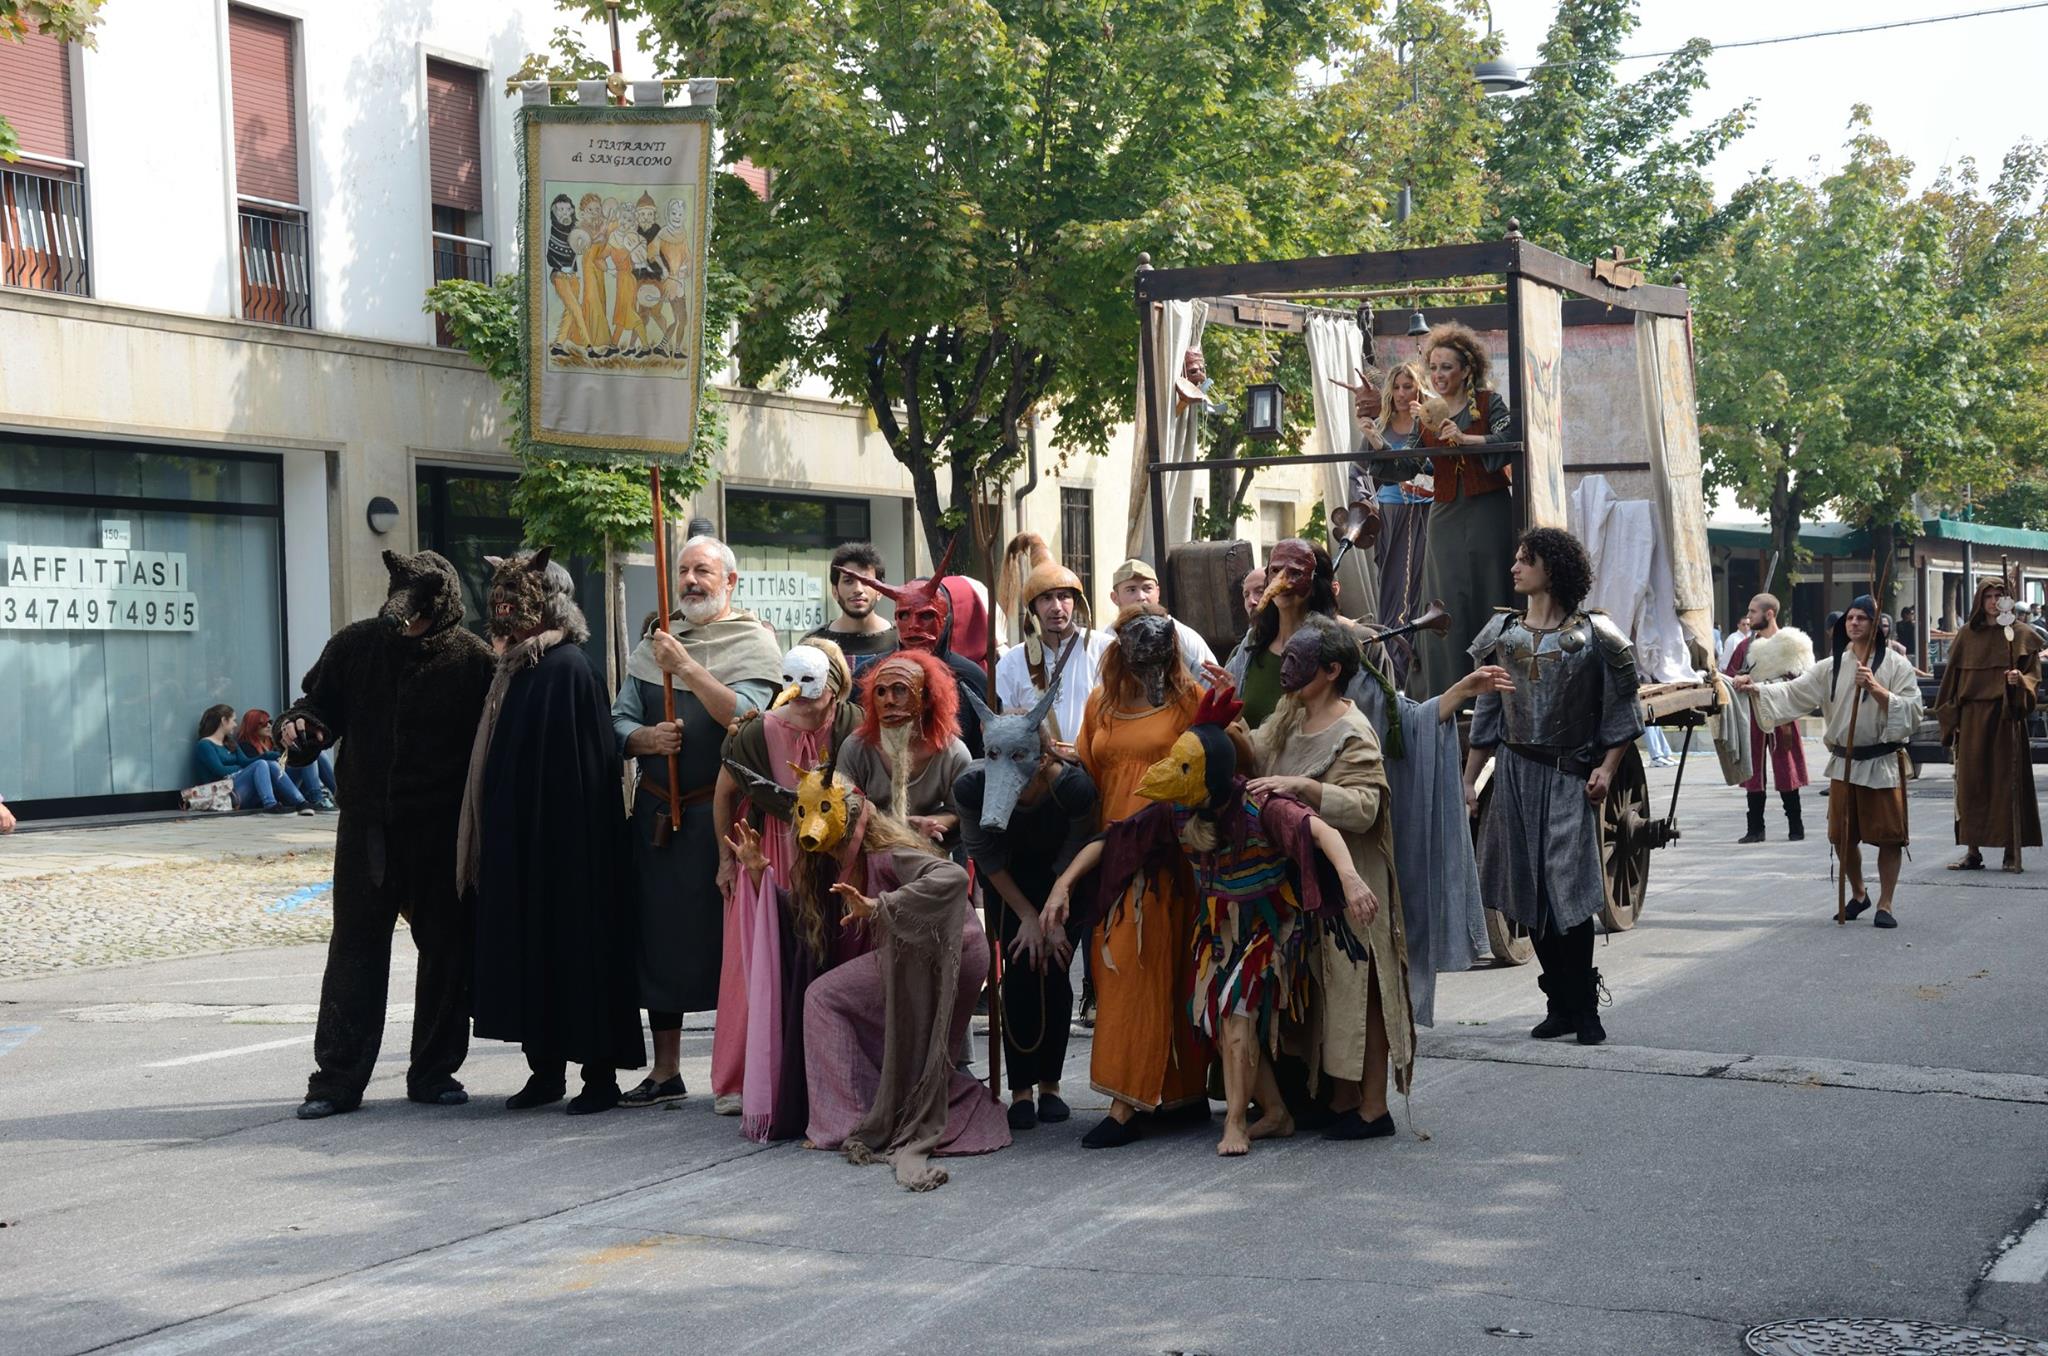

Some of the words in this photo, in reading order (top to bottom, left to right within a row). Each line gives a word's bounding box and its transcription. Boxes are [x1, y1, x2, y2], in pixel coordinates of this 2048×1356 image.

[589, 139, 595, 148] I
[571, 152, 582, 163] di
[10, 556, 180, 586] AFFITTASI
[4, 597, 195, 626] 3474974955
